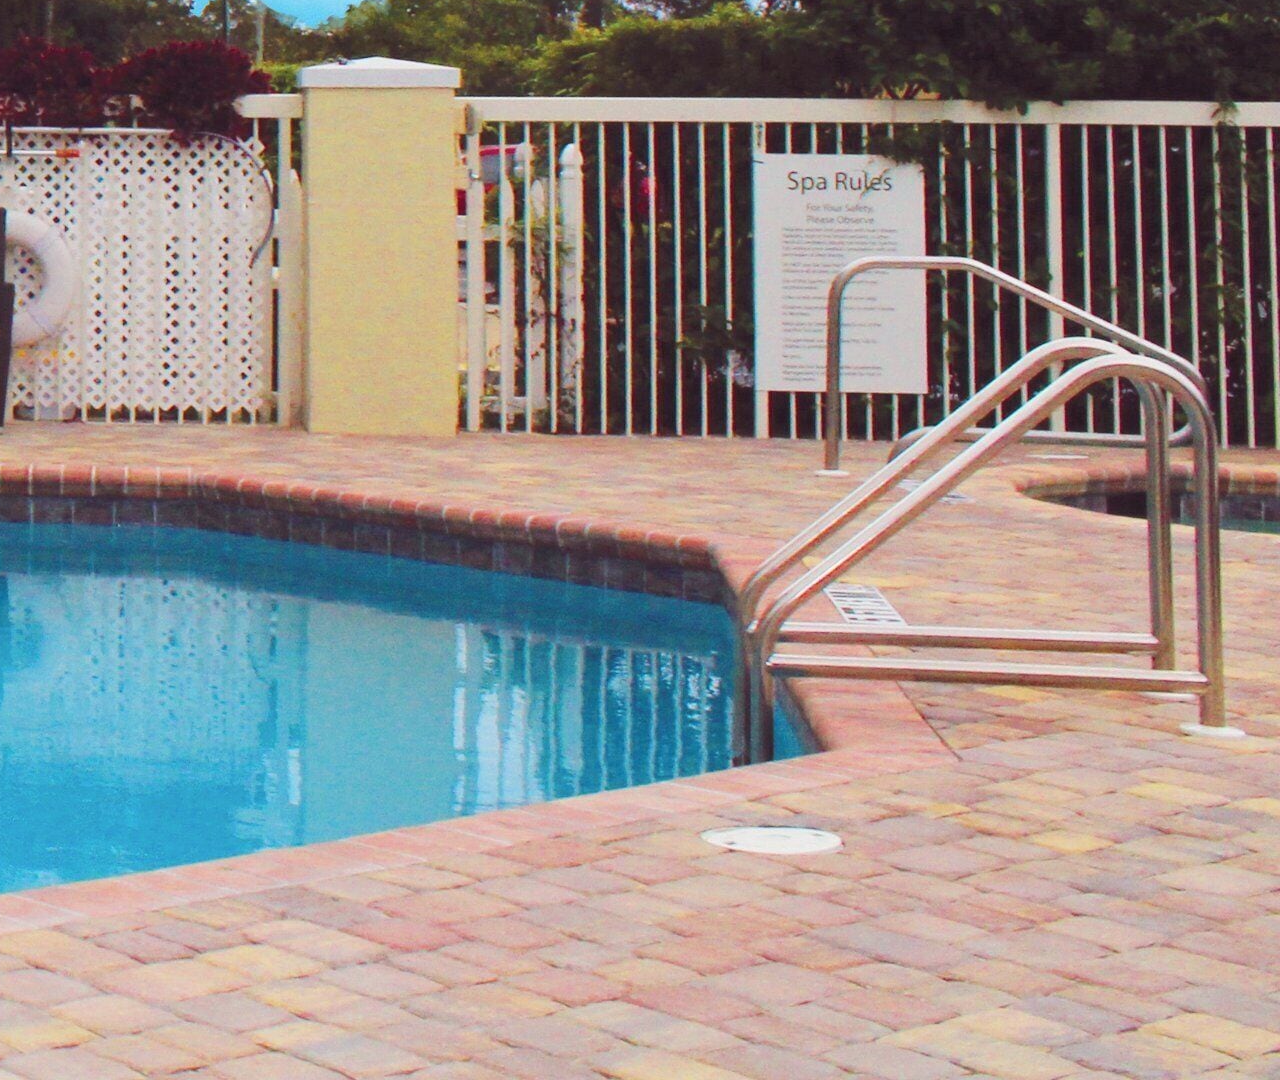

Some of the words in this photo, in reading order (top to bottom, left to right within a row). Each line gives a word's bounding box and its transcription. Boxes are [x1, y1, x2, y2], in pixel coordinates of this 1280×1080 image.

[787, 171, 827, 194] Spa
[834, 170, 892, 191] Rules
[806, 215, 835, 224] Please
